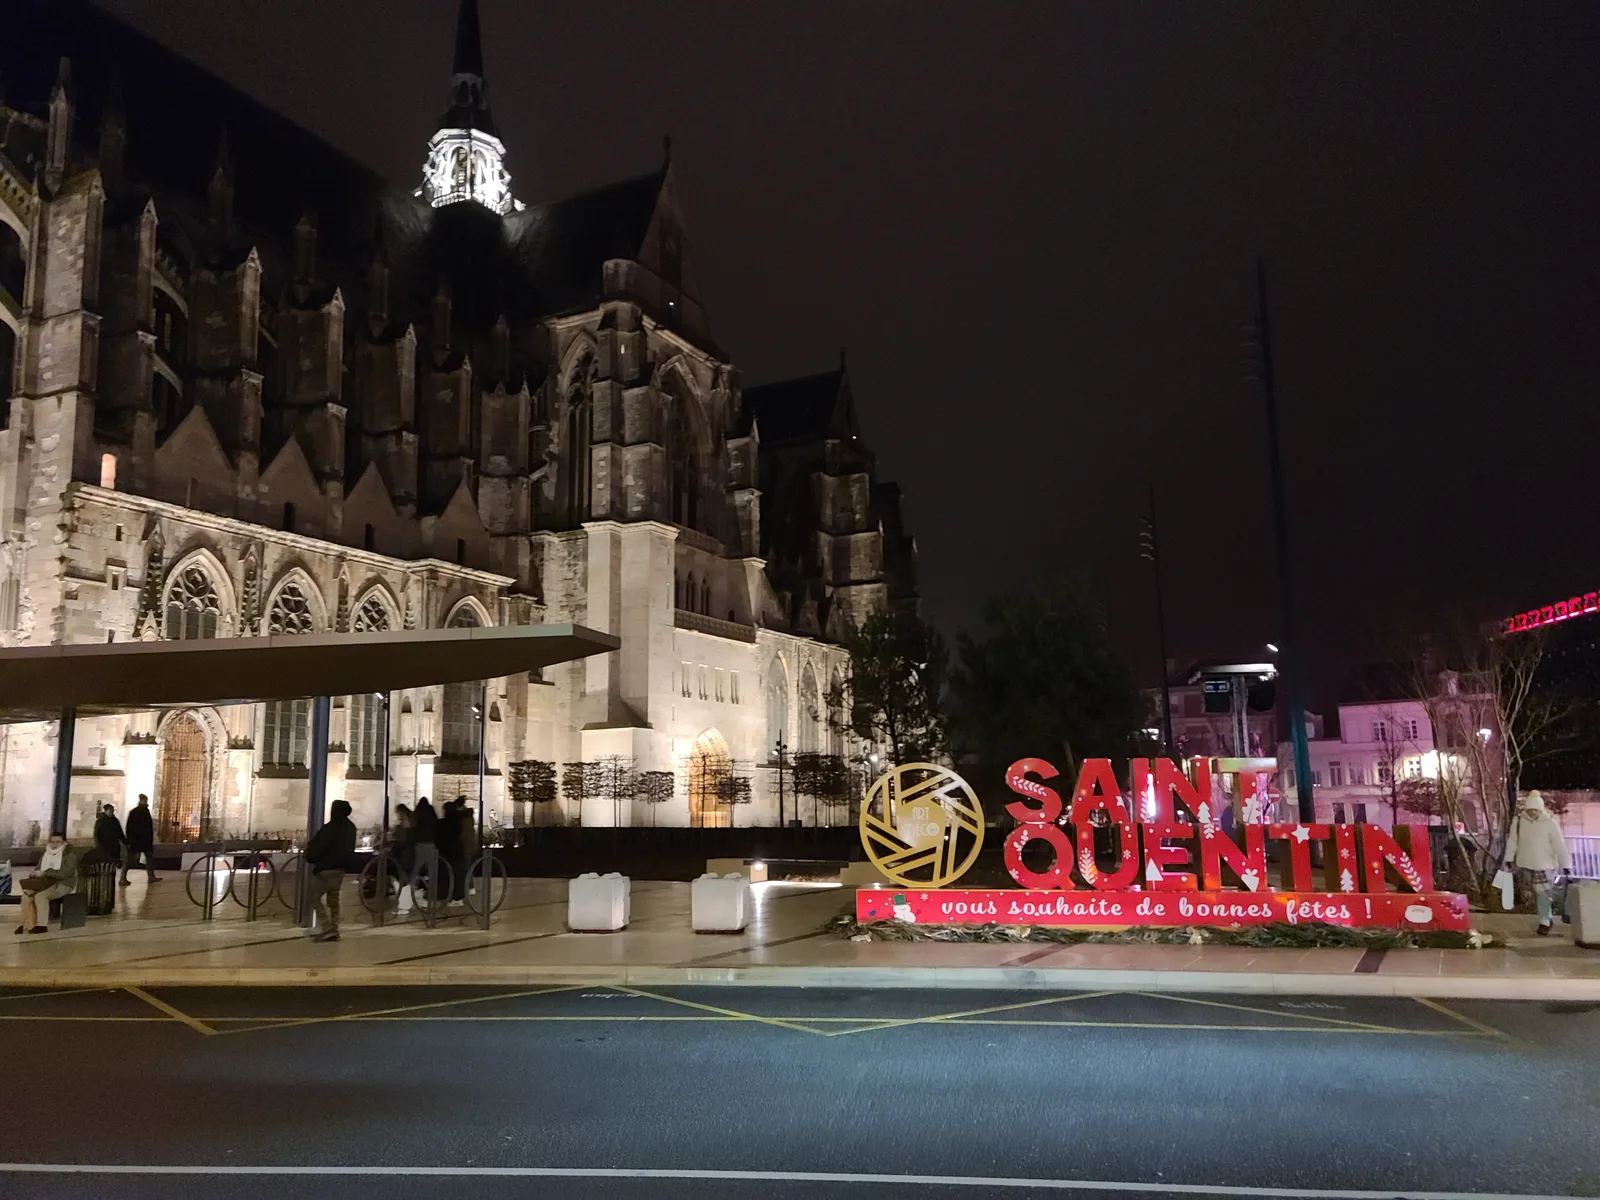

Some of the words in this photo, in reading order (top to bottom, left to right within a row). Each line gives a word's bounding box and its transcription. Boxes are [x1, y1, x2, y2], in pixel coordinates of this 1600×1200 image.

[911, 806, 930, 820] ART
[1004, 757, 1278, 824] SAINT
[1003, 822, 1434, 893] QUENTIN
[941, 900, 997, 915] vous
[1007, 897, 1123, 916] souhaite
[1136, 897, 1166, 916] de
[1179, 897, 1272, 917] bonnes
[1286, 899, 1351, 925] fêtes
[1364, 898, 1373, 919] !
